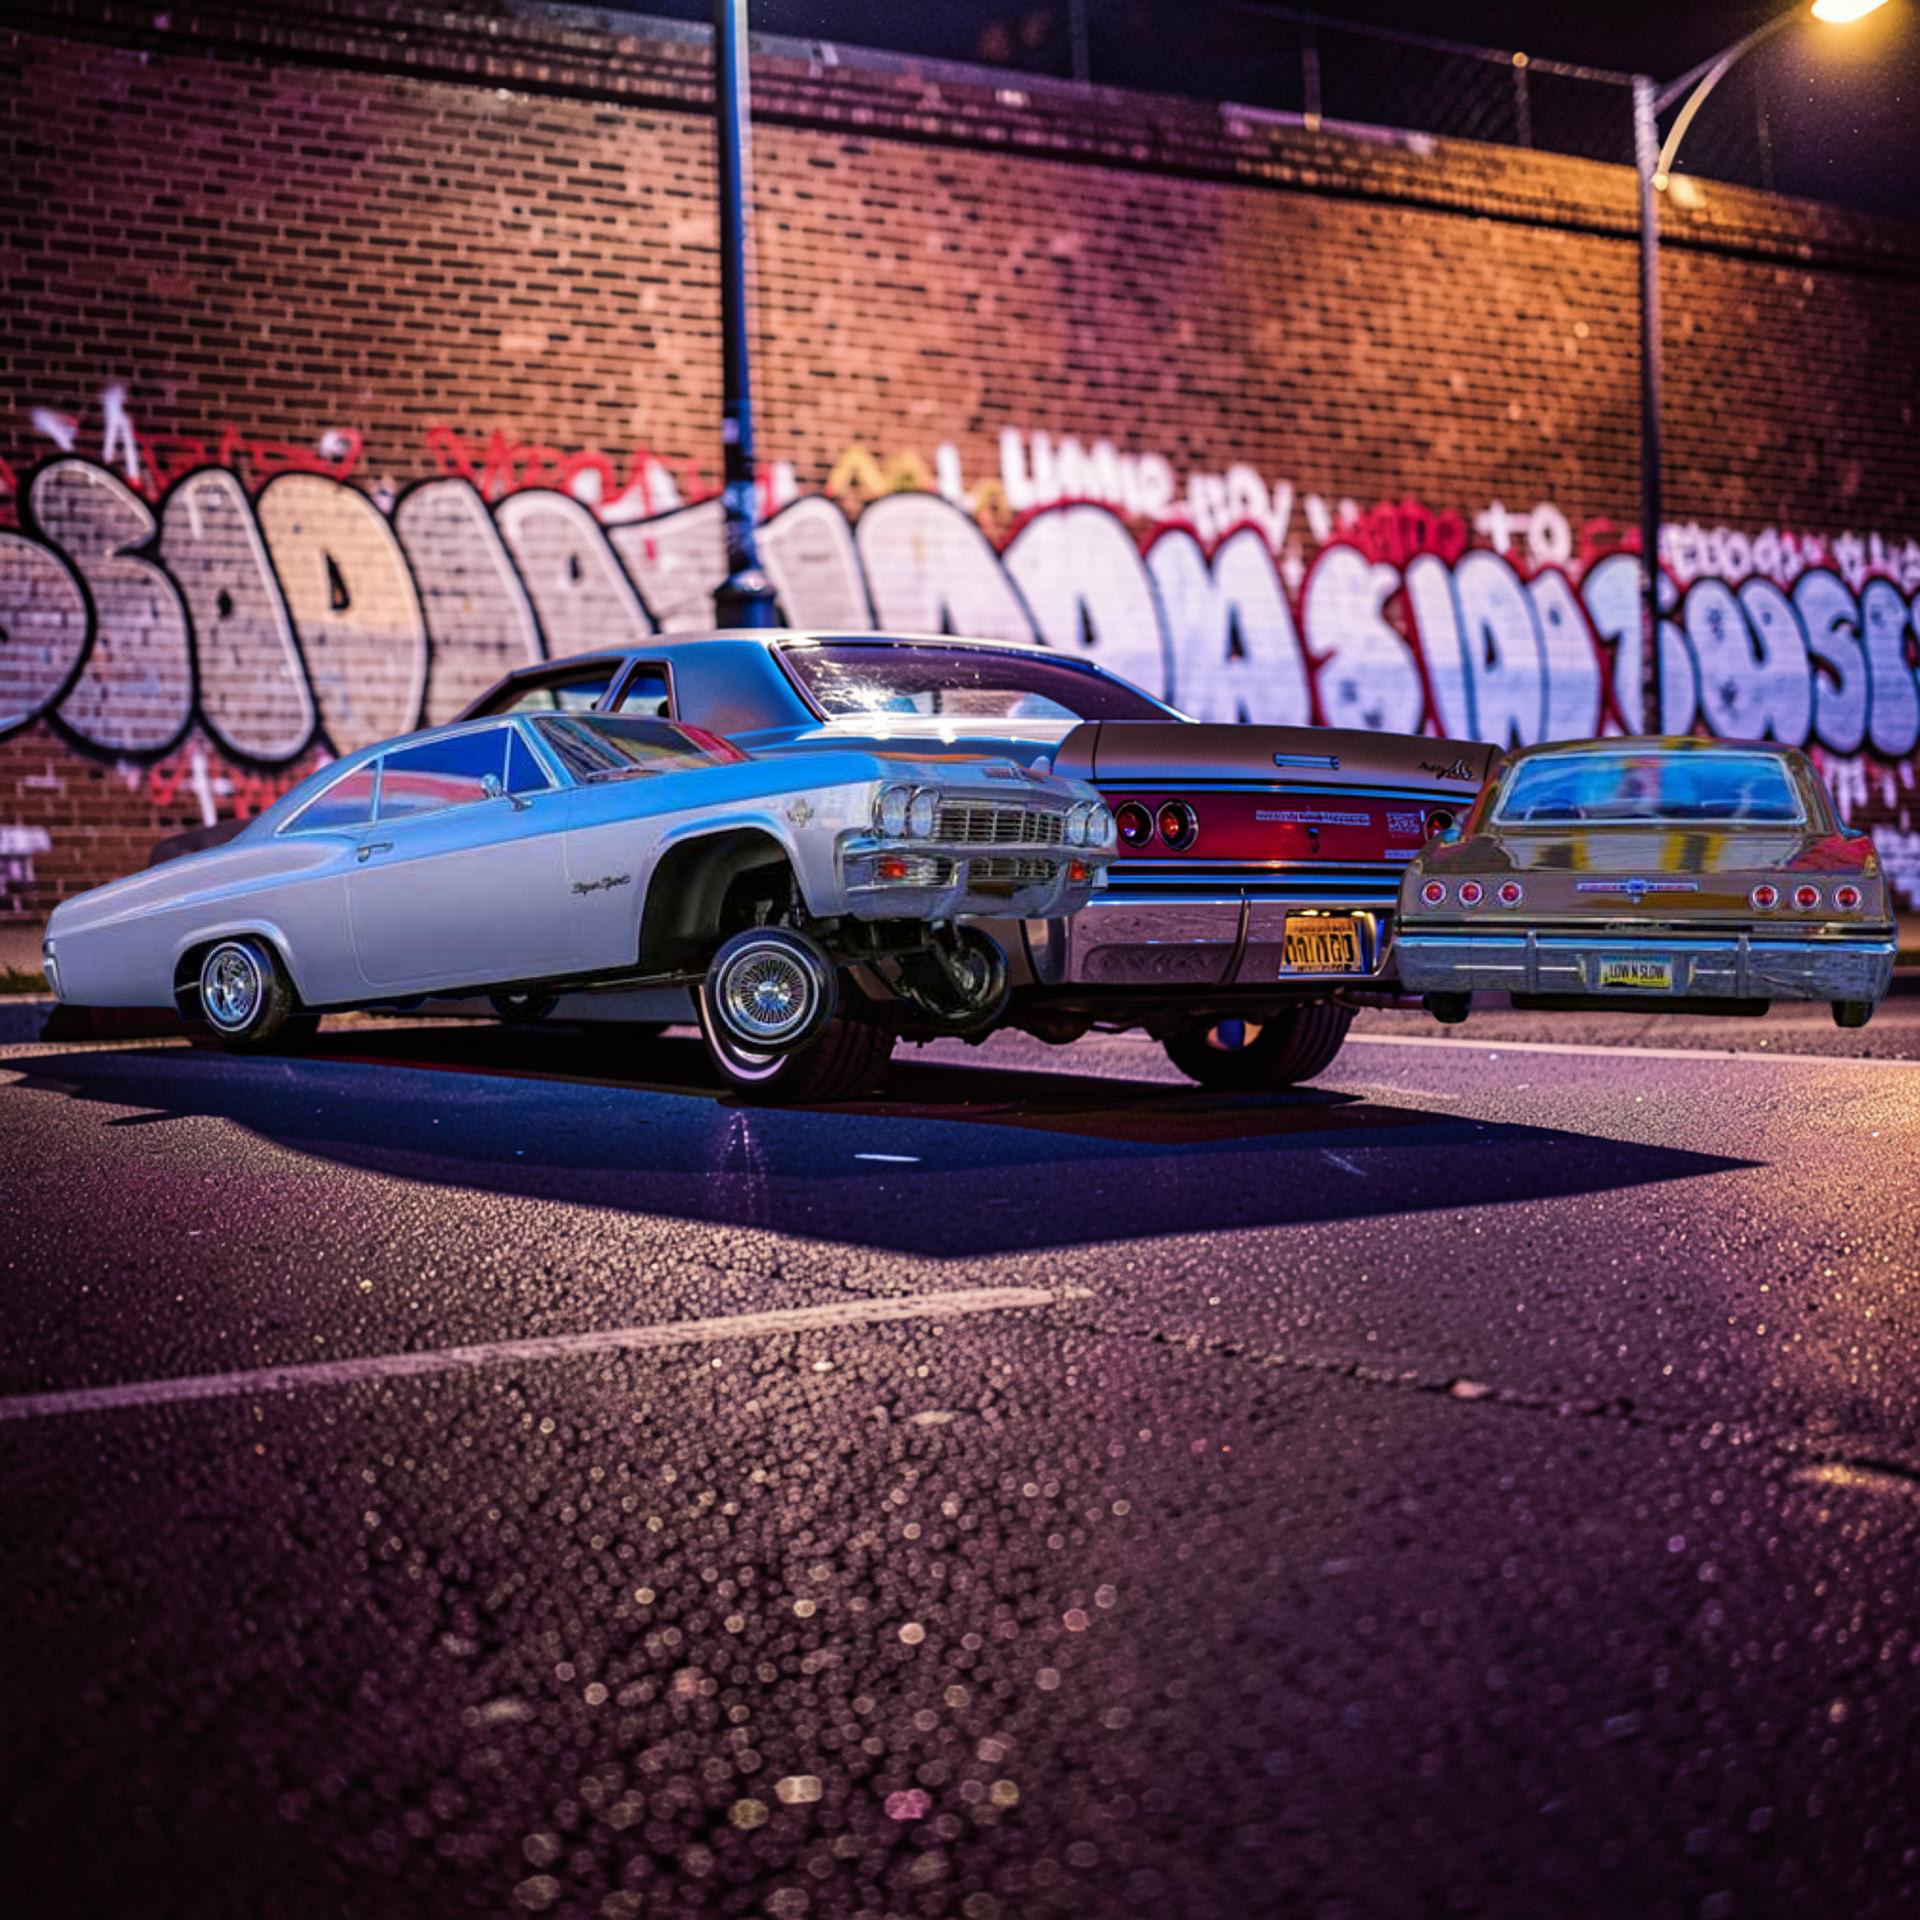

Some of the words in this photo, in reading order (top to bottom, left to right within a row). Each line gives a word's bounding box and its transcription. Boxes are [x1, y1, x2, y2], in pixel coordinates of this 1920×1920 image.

[1610, 964, 1629, 978] LOW
[1631, 964, 1639, 978] N
[1640, 964, 1665, 979] SLOW
